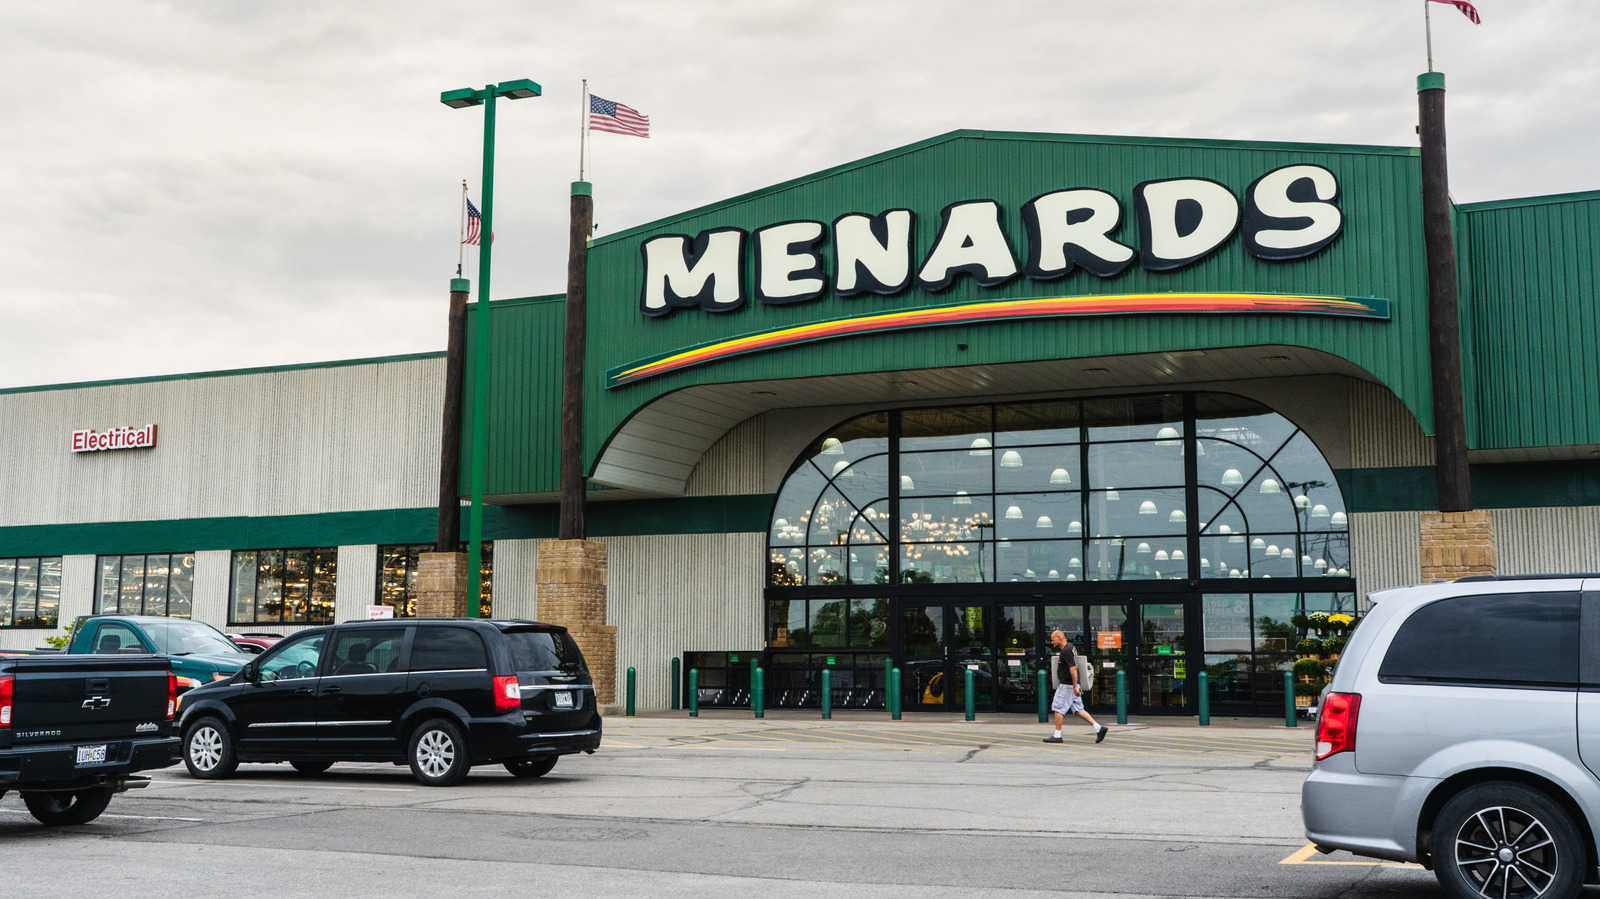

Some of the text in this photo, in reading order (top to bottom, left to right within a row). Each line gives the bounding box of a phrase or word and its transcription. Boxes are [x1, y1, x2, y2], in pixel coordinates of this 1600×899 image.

[642, 164, 1343, 316] MENARDS
[73, 425, 152, 450] Electrical
[16, 730, 61, 738] SILVERADO
